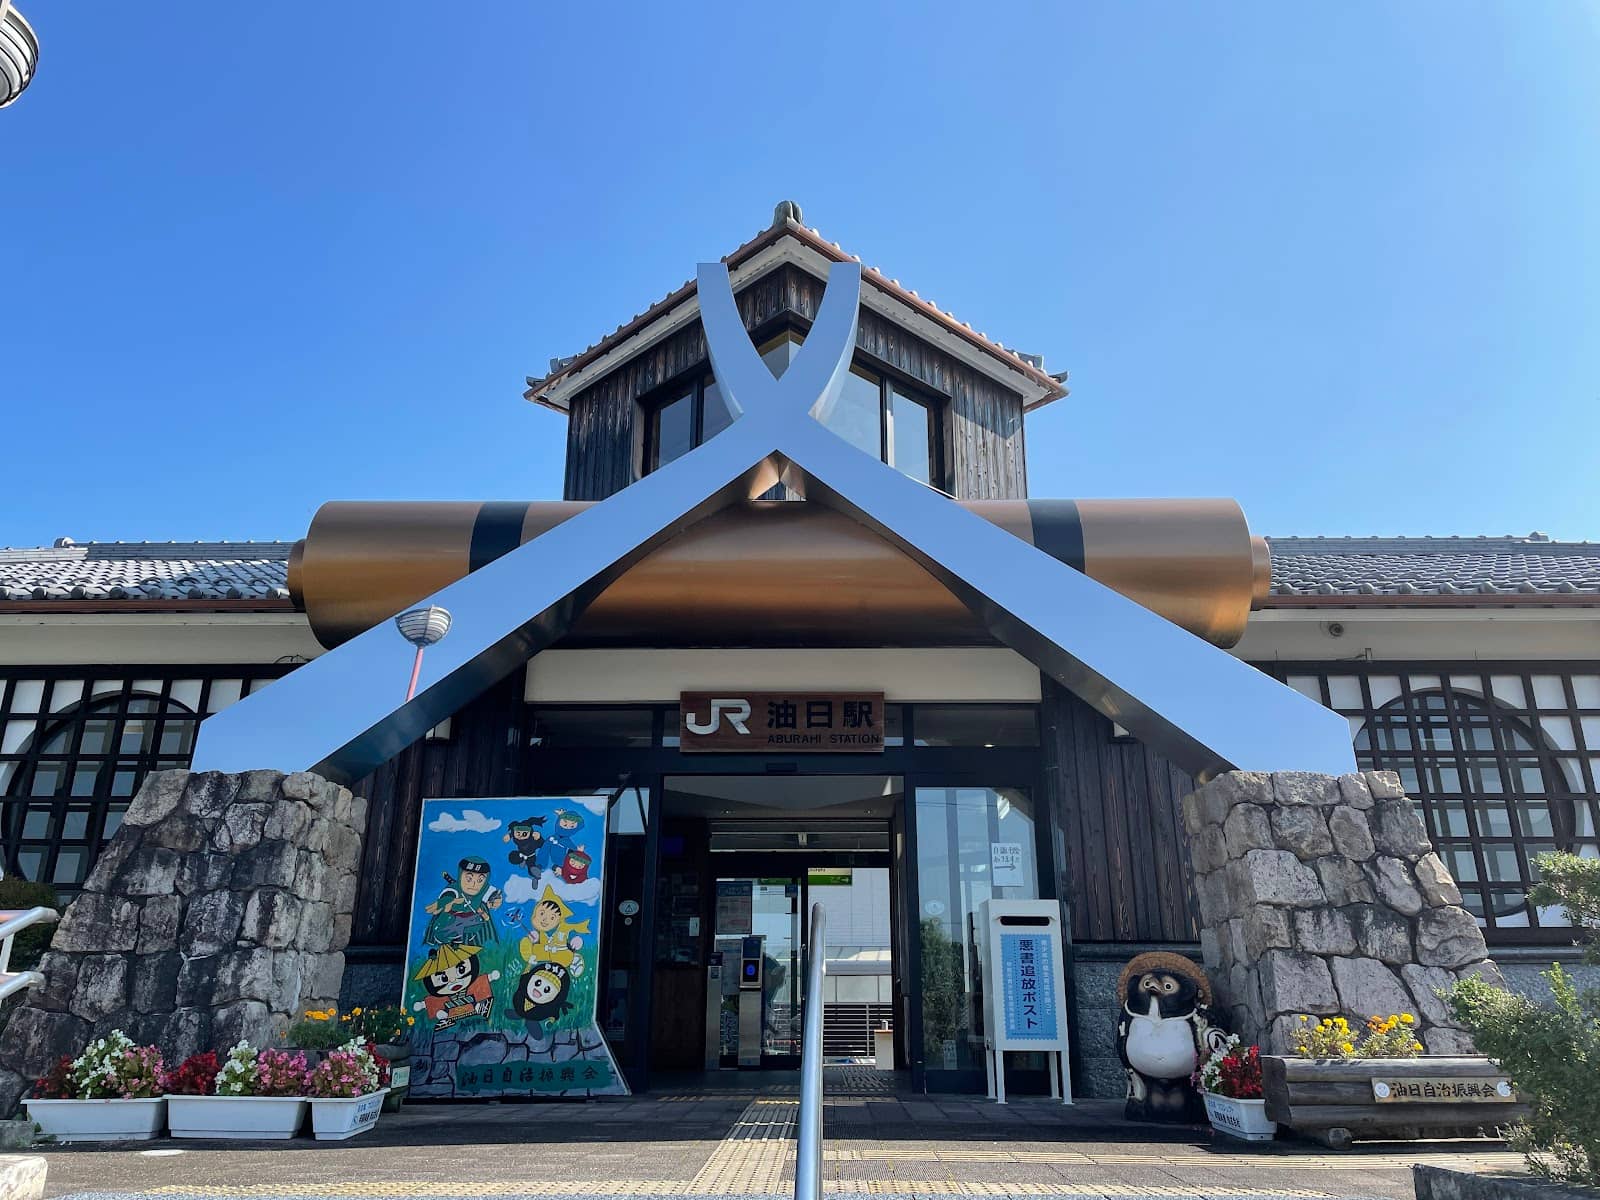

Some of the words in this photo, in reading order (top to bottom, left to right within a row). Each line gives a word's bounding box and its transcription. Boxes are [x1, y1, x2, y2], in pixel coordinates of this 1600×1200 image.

[686, 698, 752, 735] JR
[767, 700, 874, 729] 油日駅
[767, 734, 822, 744] ABURAHI
[831, 734, 880, 744] STATION
[1019, 939, 1038, 1029] 悪書追放ポスト
[1390, 1081, 1497, 1099] 油日自治振興会
